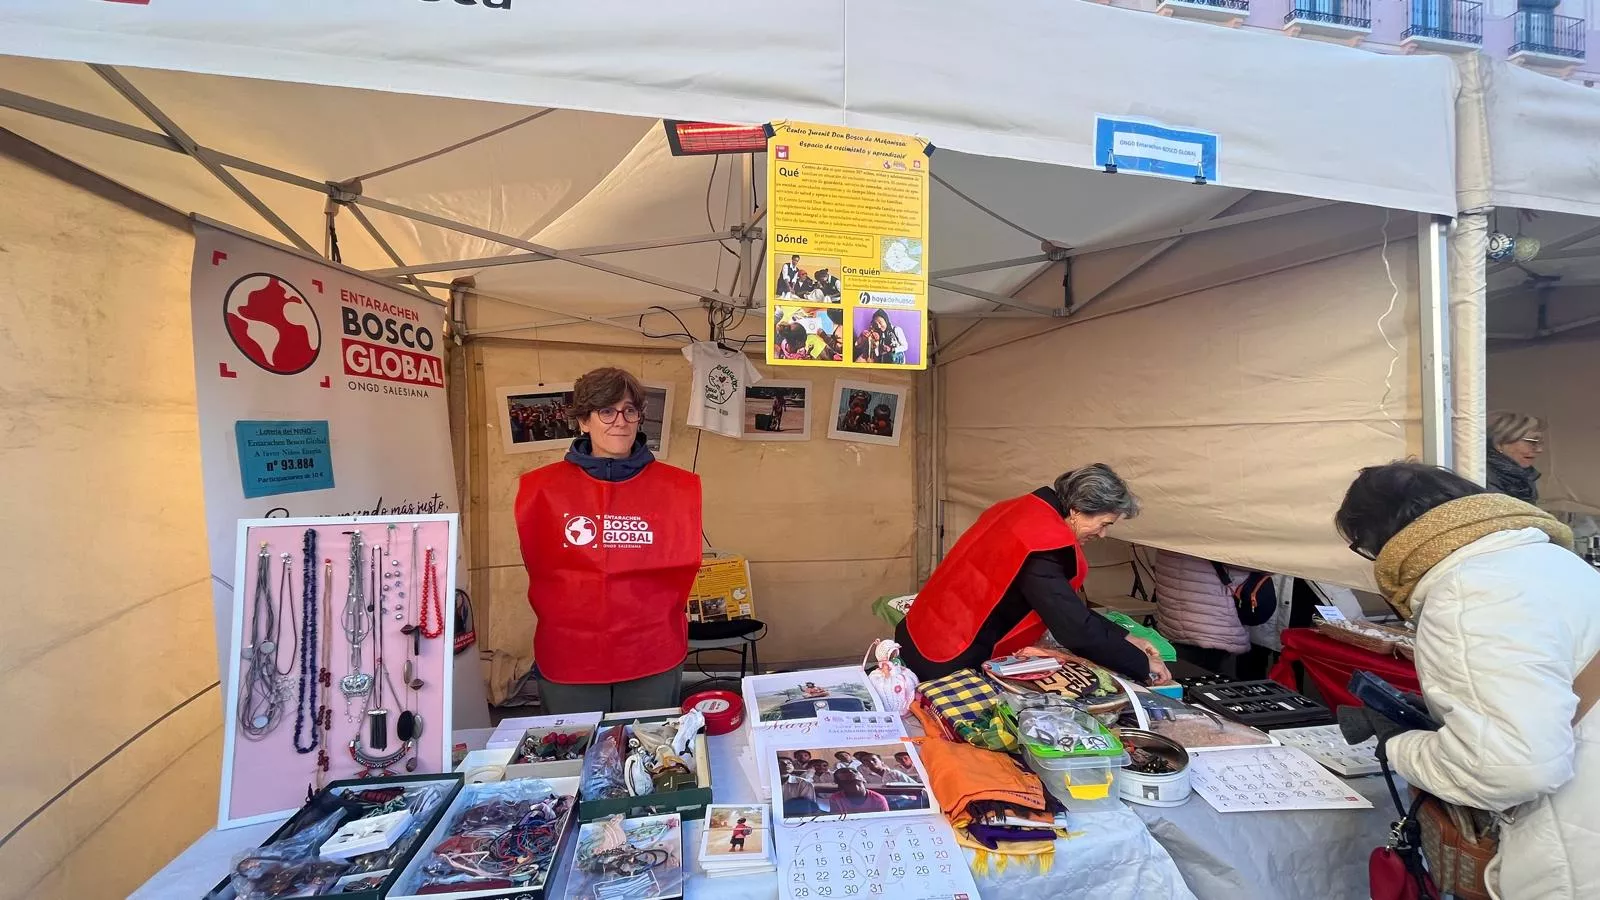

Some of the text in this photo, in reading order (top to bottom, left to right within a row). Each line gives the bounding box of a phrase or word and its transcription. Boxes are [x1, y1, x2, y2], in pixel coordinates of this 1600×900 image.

[800, 141, 823, 150] Espacio
[834, 145, 866, 154] crecimiento
[1162, 146, 1178, 154] BOSCO
[1179, 149, 1196, 157] GLOBAL
[779, 167, 800, 178] Qué
[776, 234, 808, 244] Dónde
[842, 266, 880, 276] Con quién
[340, 288, 419, 322] ENTARACHEN
[342, 306, 434, 352] BOSCO
[346, 344, 442, 384] GLOBAL
[348, 381, 428, 398] ONGD SALESIANA
[306, 437, 326, 445] Global
[281, 458, 314, 470] 93.884
[391, 500, 415, 516] más
[416, 493, 449, 515] justo.
[604, 520, 648, 530] BOSCO
[604, 532, 651, 542] GLOBAL
[838, 830, 844, 838] 2
[860, 829, 868, 837] 3
[906, 826, 912, 834] 5
[794, 836, 943, 853] 7 8 9 10 11 12 13
[794, 851, 948, 867] 14 15 16 17 18 19 20
[794, 864, 951, 881] 21 22 23 24 25 26 27
[795, 888, 809, 897] 28
[818, 886, 832, 896] 29
[845, 885, 858, 894] 30
[870, 883, 883, 892] 31
